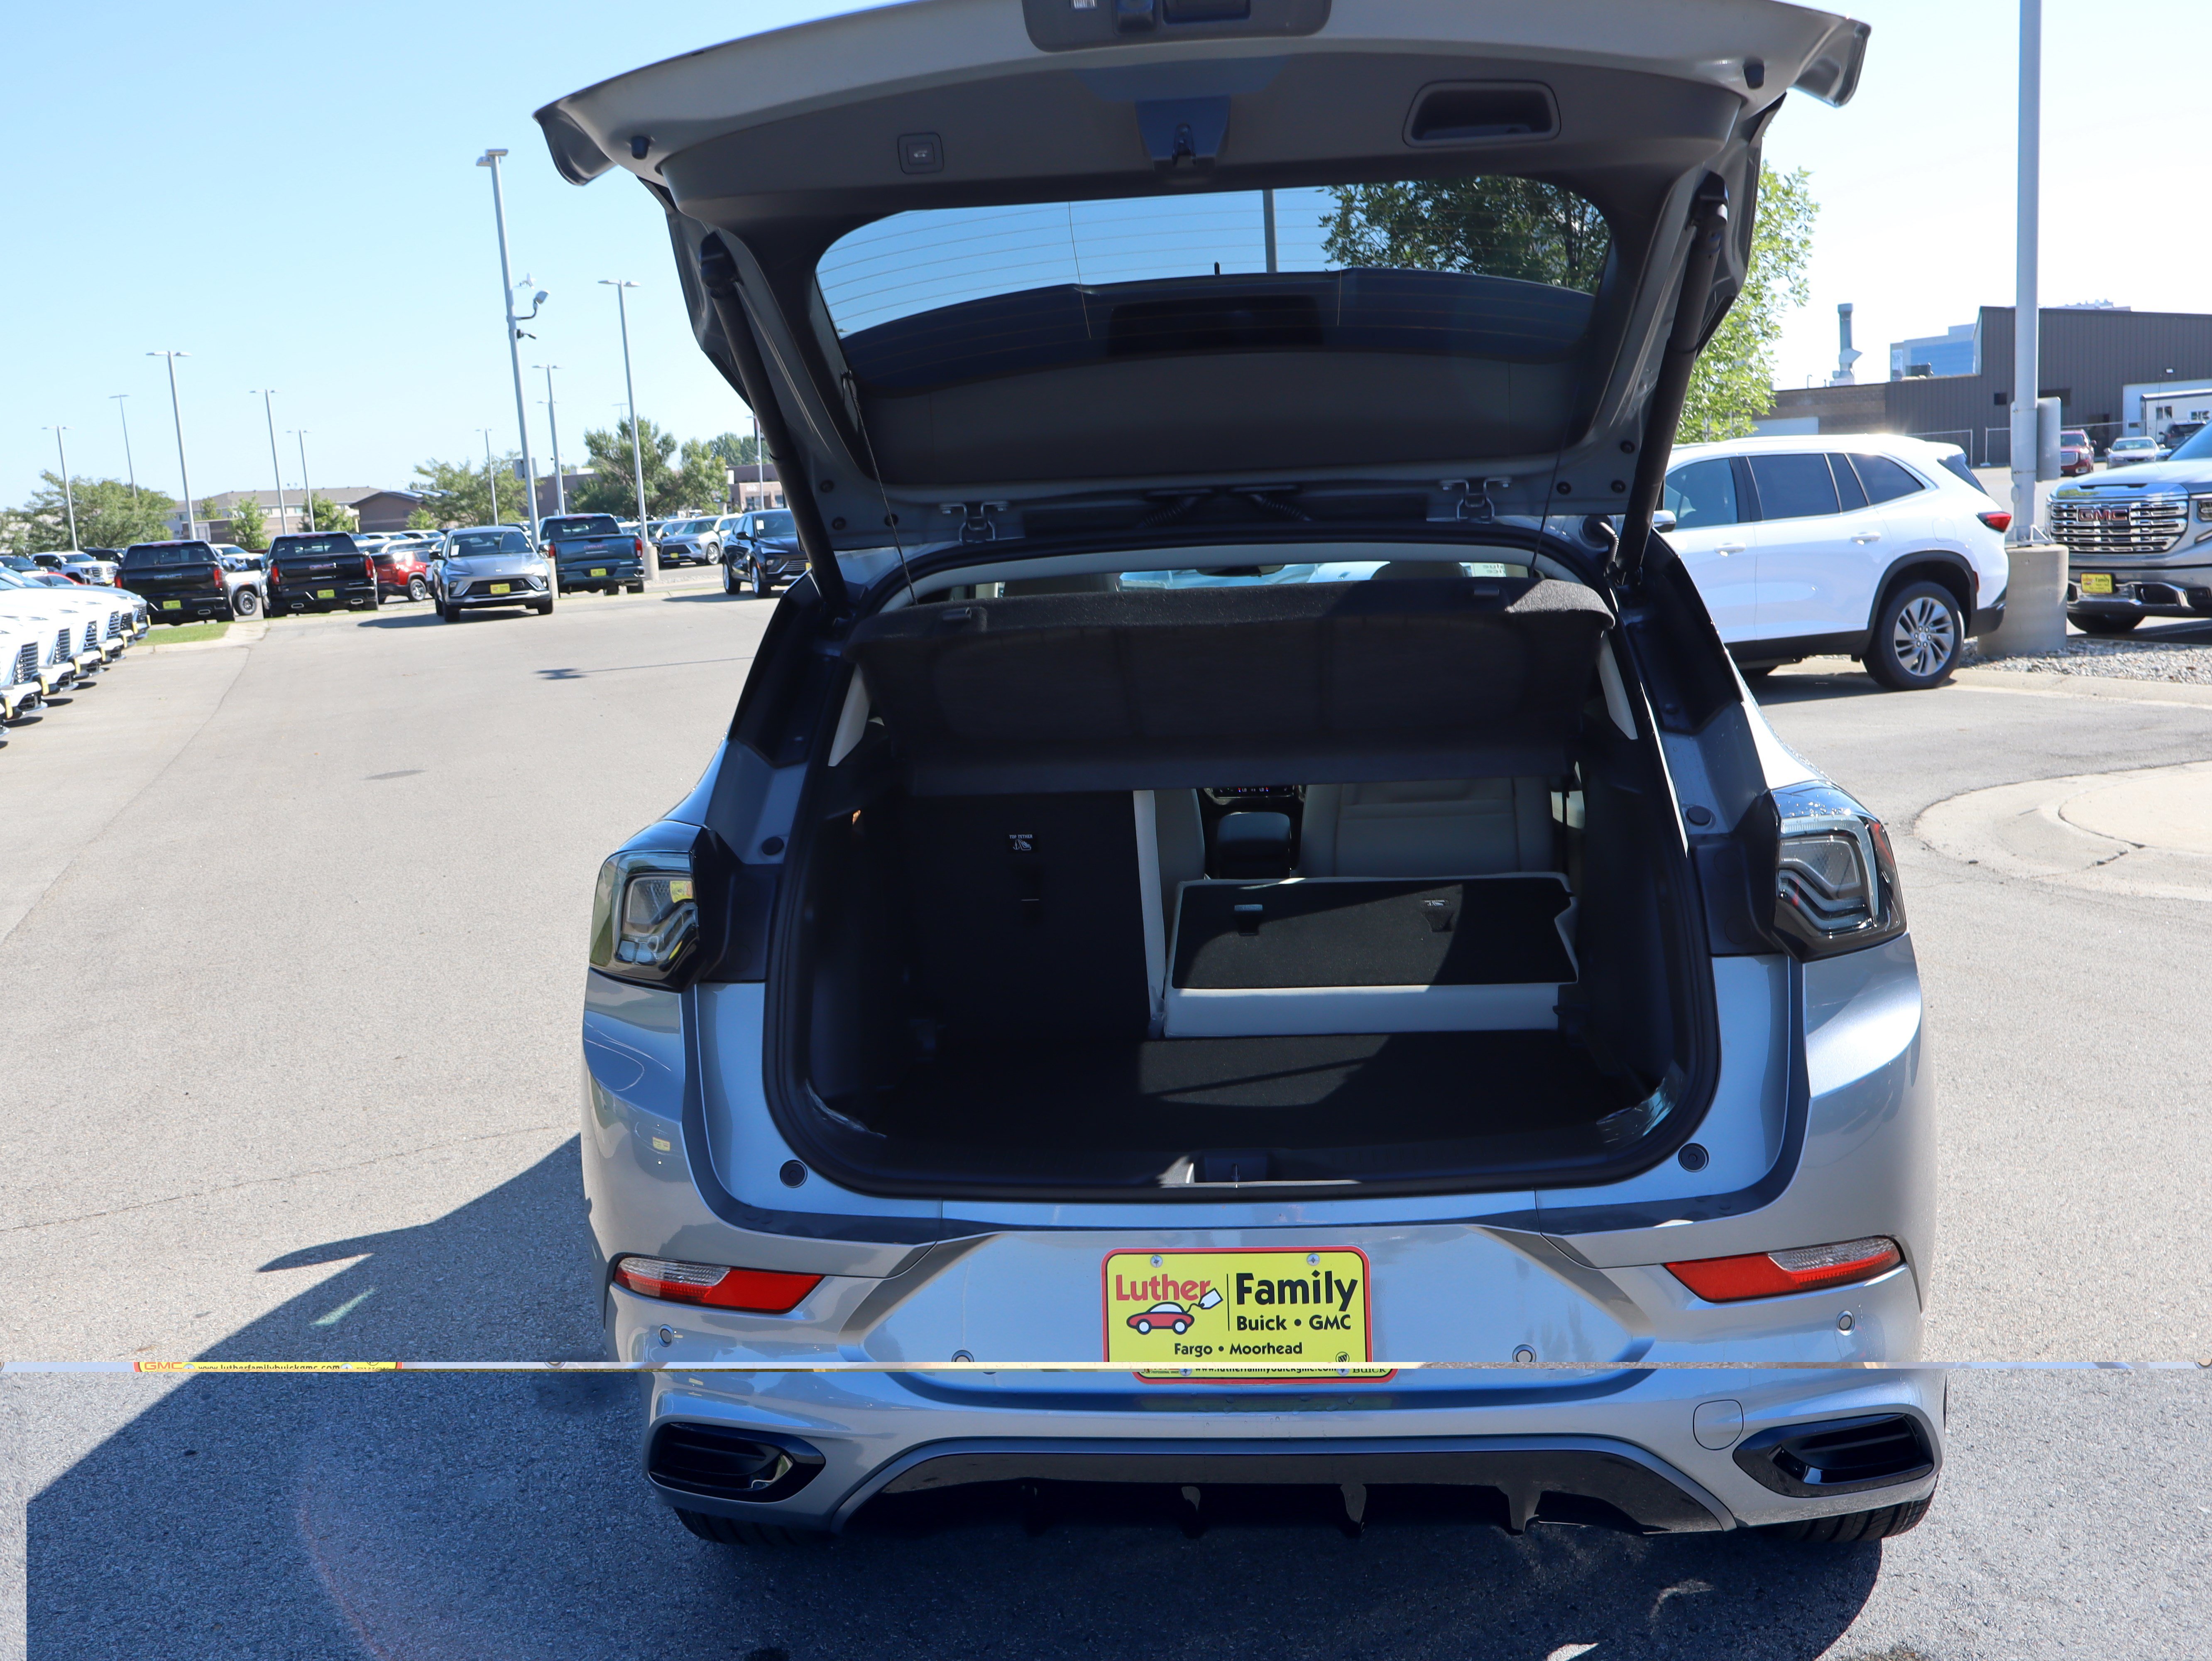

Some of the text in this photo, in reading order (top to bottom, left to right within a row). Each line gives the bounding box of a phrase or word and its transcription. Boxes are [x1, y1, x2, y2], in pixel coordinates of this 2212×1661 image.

[2080, 510, 2127, 521] GMC
[1116, 1270, 1358, 1311] Luther Family
[1237, 1315, 1351, 1330] Buick GMC
[1175, 1342, 1302, 1357] Fargo Moorhead
